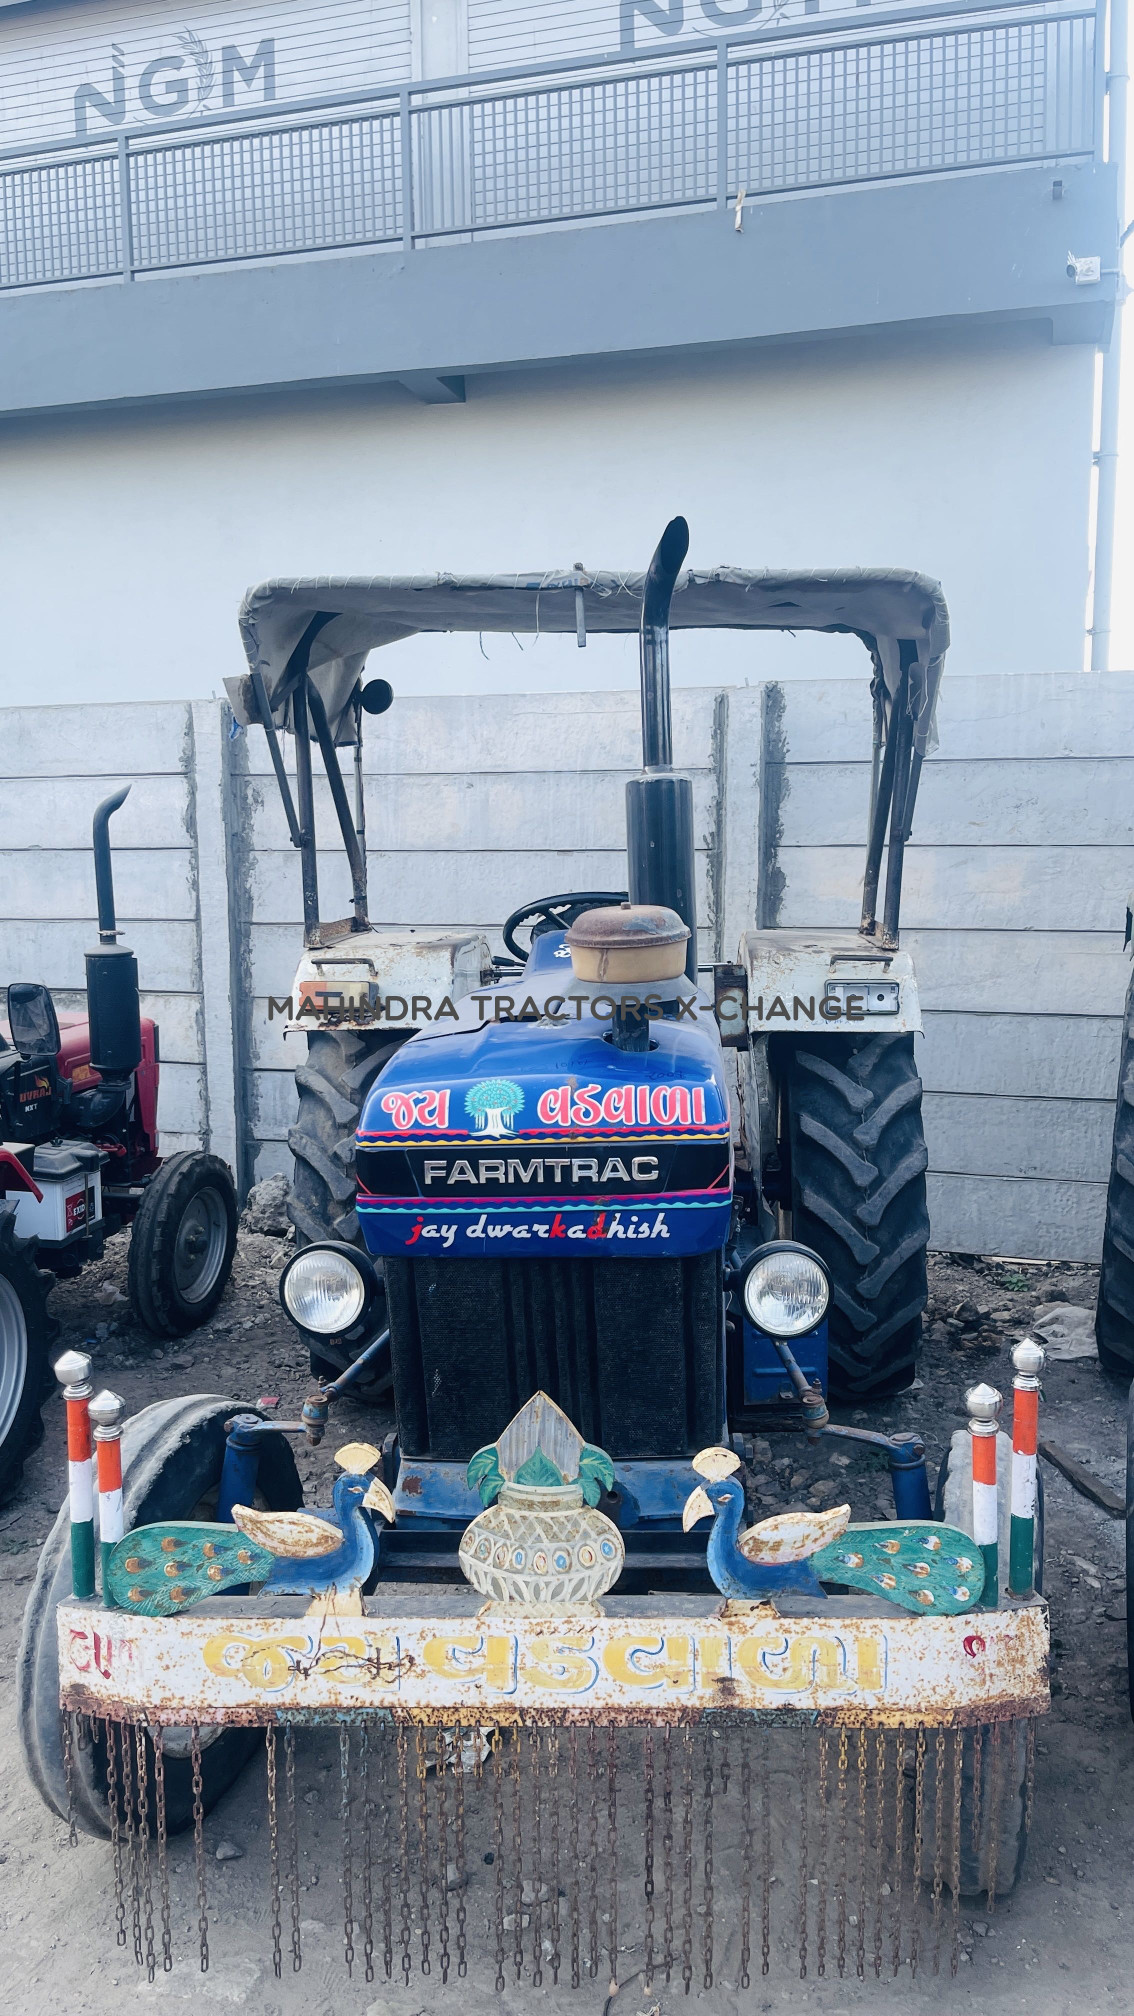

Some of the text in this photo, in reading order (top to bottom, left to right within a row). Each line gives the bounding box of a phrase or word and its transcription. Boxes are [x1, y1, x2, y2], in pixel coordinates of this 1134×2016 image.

[74, 37, 276, 137] NGM
[19, 1086, 52, 1103] UVRAJ
[24, 1103, 39, 1113] NXT
[381, 1084, 708, 1131] જય વડવાળા
[423, 1156, 660, 1185] FARMTRAC
[73, 1204, 87, 1217] EXID
[405, 1213, 671, 1248] jay dwarkadhish
[203, 1634, 401, 1693] જય
